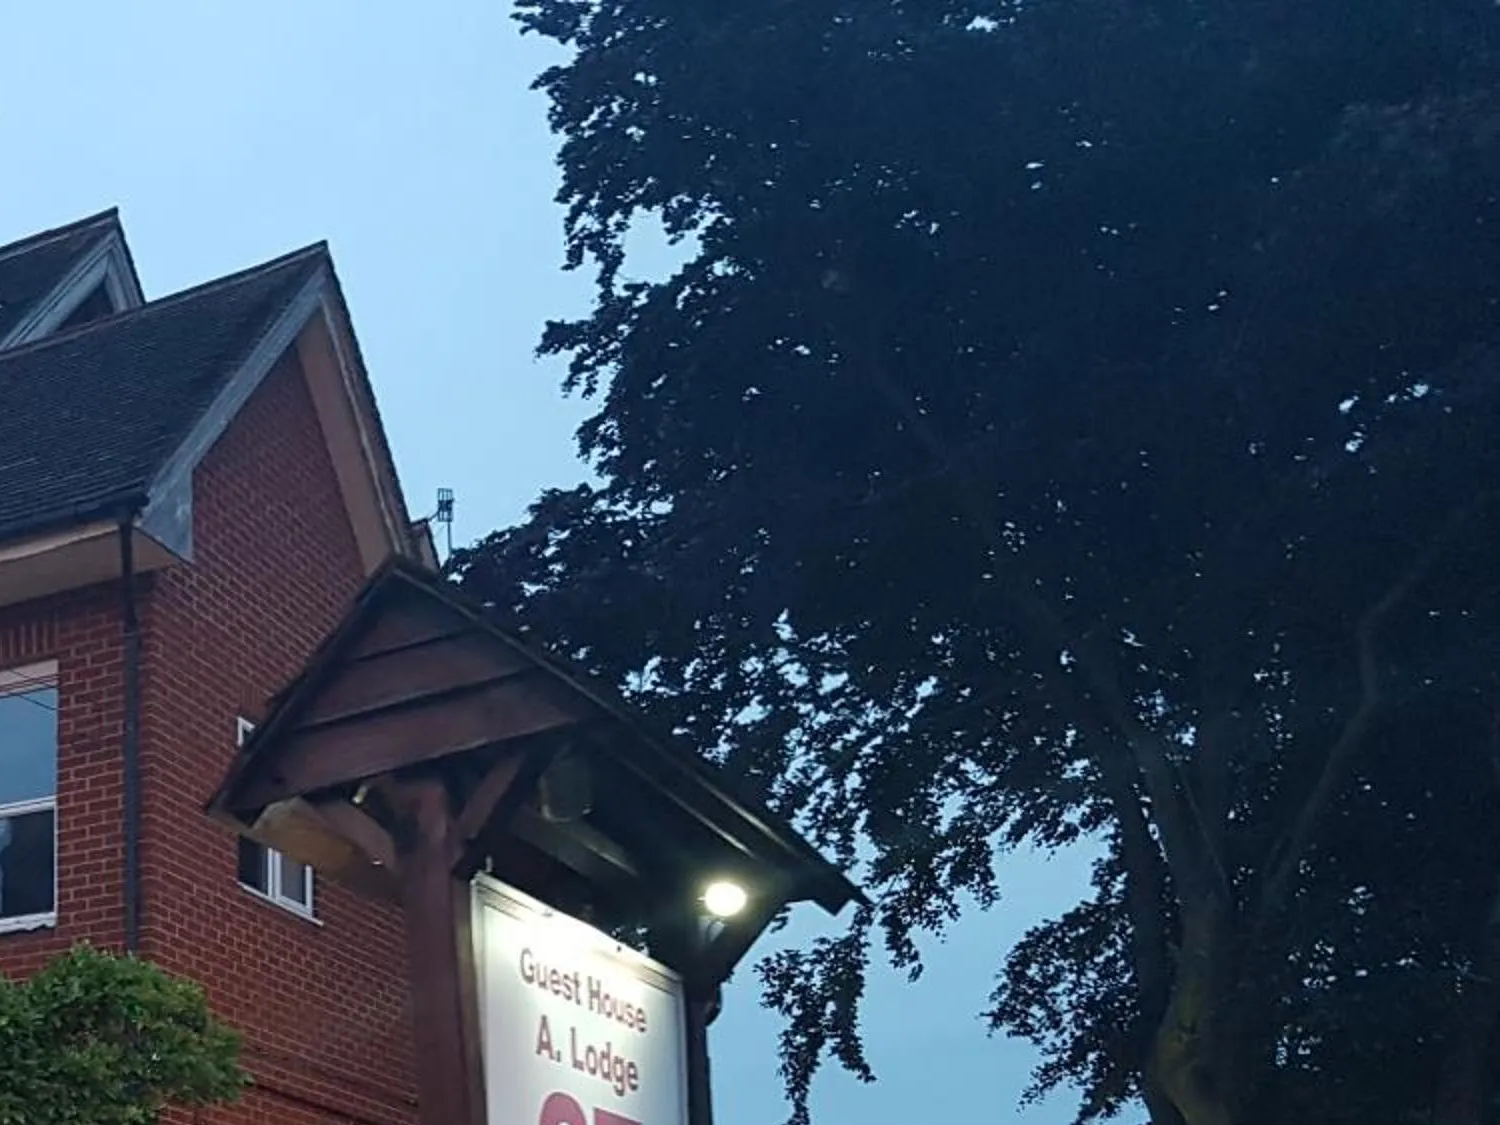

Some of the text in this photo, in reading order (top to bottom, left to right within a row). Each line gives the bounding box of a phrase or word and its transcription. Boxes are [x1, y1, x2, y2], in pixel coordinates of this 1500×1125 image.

[519, 948, 647, 1032] Guest House
[536, 1014, 639, 1097] A. Lodge
